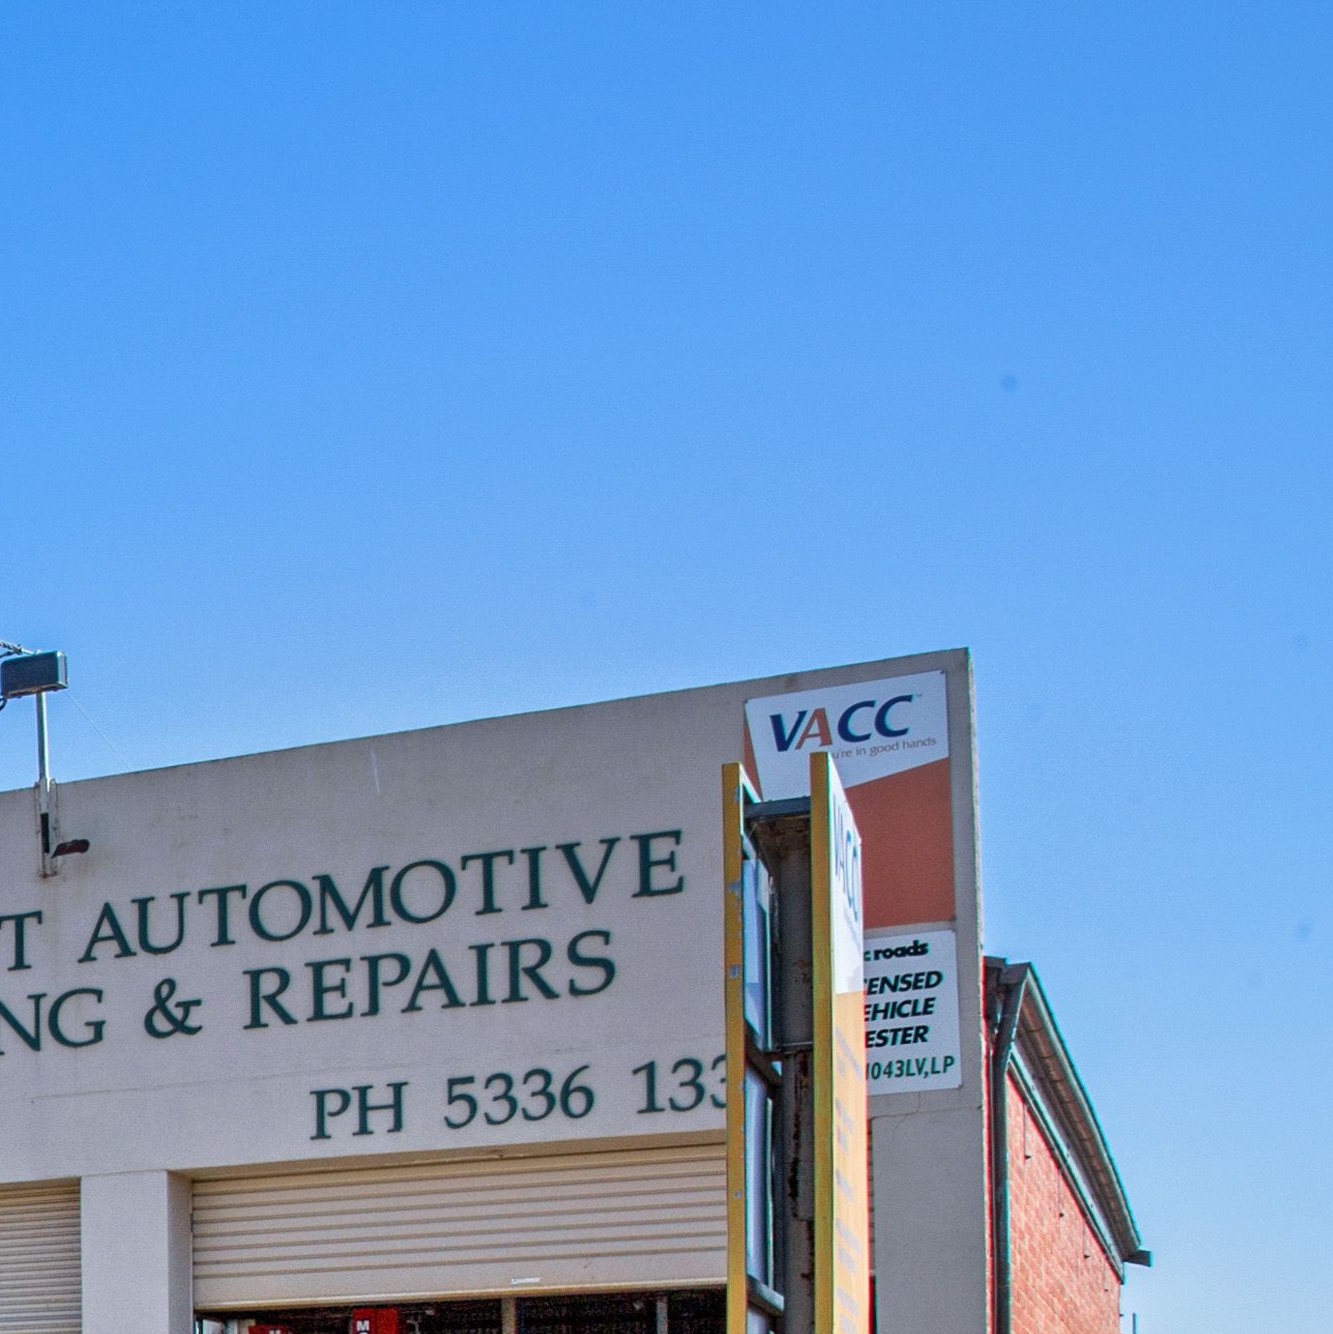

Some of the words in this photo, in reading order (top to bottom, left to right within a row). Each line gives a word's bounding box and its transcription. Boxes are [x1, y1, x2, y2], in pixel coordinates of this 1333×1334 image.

[769, 694, 913, 752] VACC
[856, 747, 866, 756] in
[869, 743, 899, 757] good
[902, 736, 936, 749] hands
[78, 829, 684, 963] AUTOMOTIVE
[873, 939, 929, 960] roads
[143, 977, 203, 1039] &
[243, 929, 616, 1029] REPAIRS
[864, 970, 943, 996] ENSED
[309, 1081, 409, 1140] PH
[444, 1065, 595, 1129] 5336
